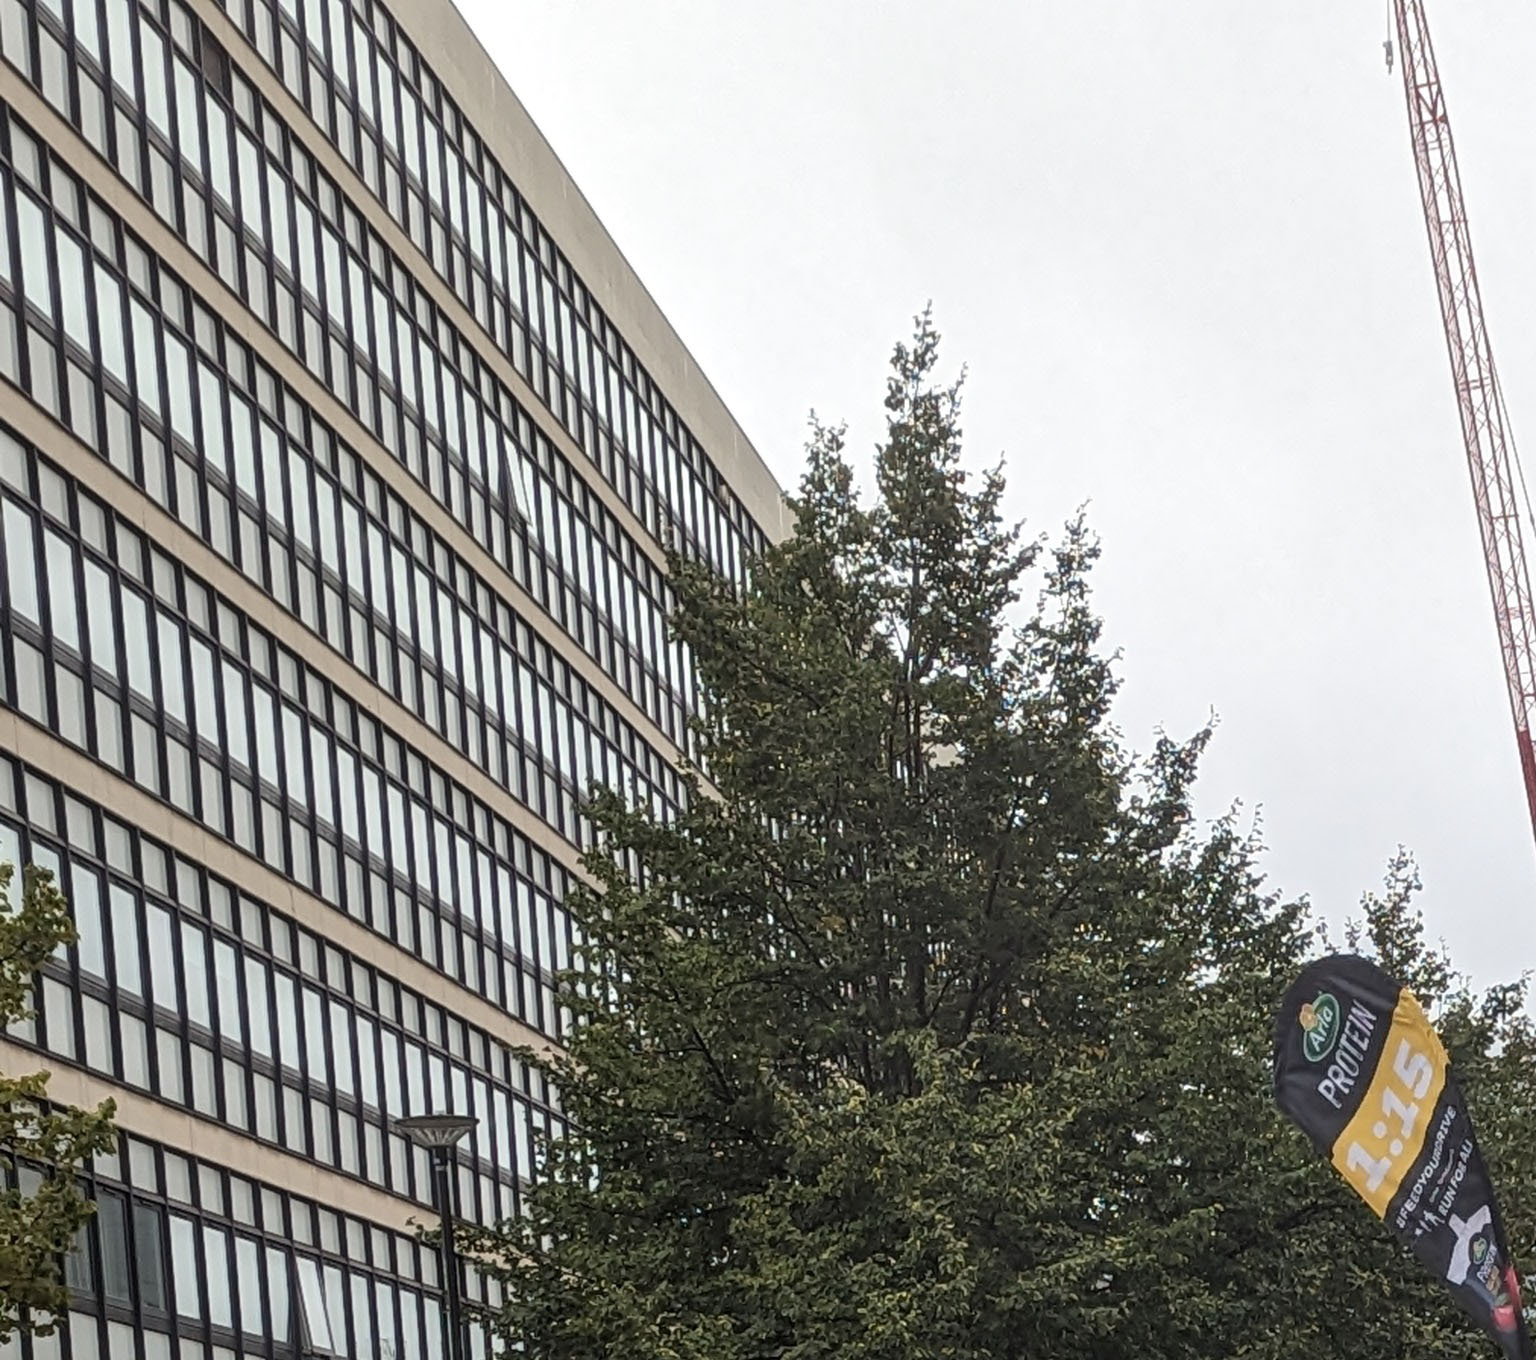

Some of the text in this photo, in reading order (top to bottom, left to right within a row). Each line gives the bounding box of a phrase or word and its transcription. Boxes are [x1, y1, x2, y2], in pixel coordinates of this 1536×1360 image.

[1309, 1006, 1334, 1052] Arla
[1318, 999, 1377, 1109] PROTEIN
[1346, 1036, 1434, 1193] 1:15
[1438, 1187, 1457, 1217] RUN
